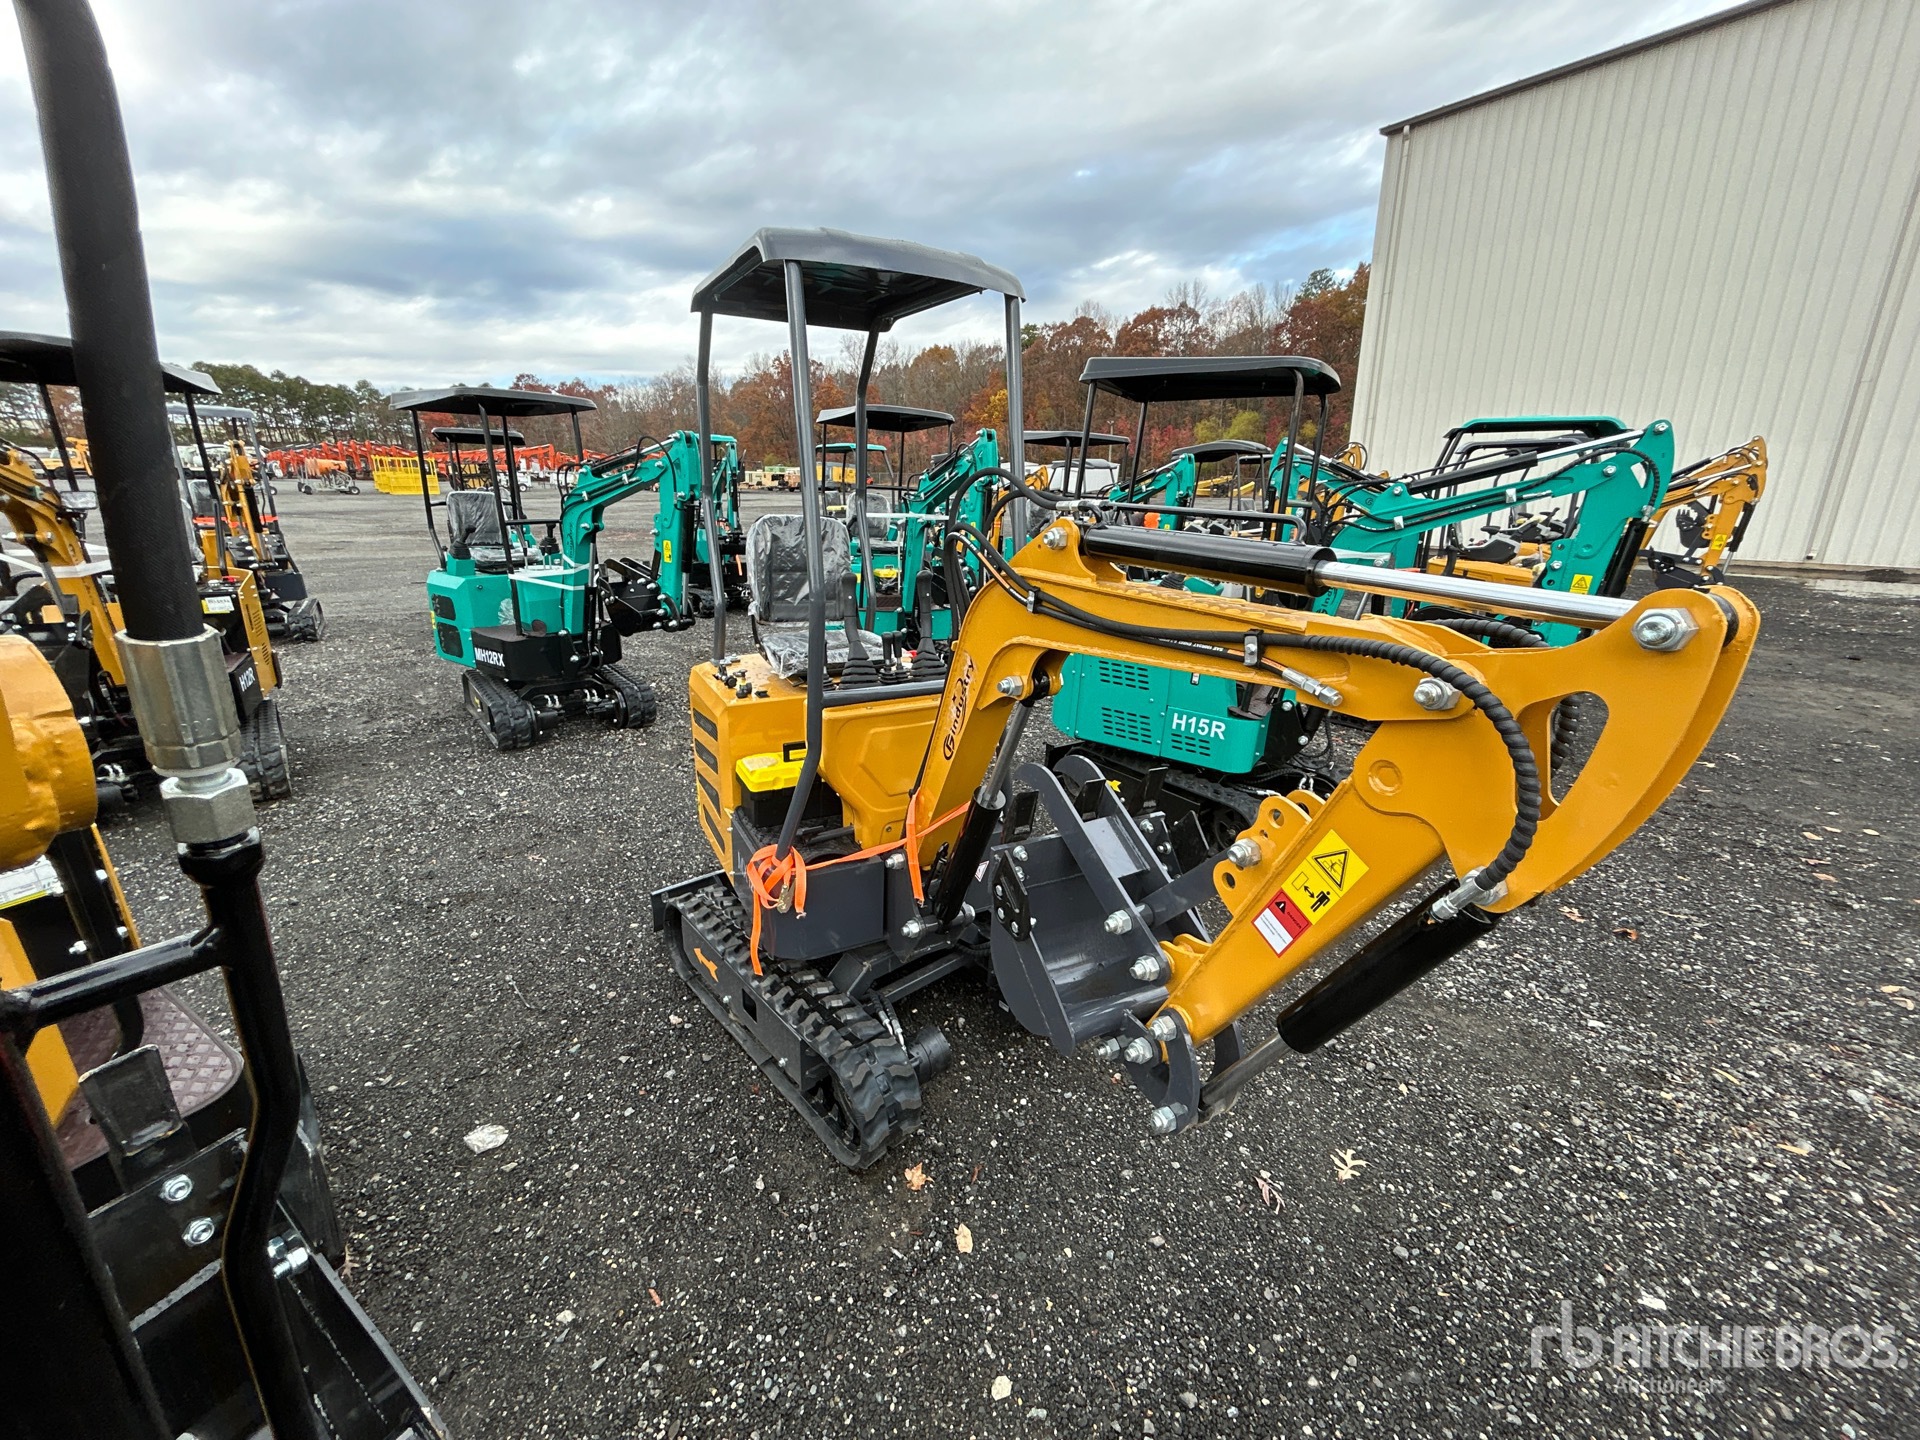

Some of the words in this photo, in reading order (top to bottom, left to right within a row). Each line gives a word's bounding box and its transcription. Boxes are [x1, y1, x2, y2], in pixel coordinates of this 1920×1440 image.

[474, 647, 506, 667] MH12RX
[238, 666, 256, 692] H12R
[1171, 712, 1226, 740] H15R
